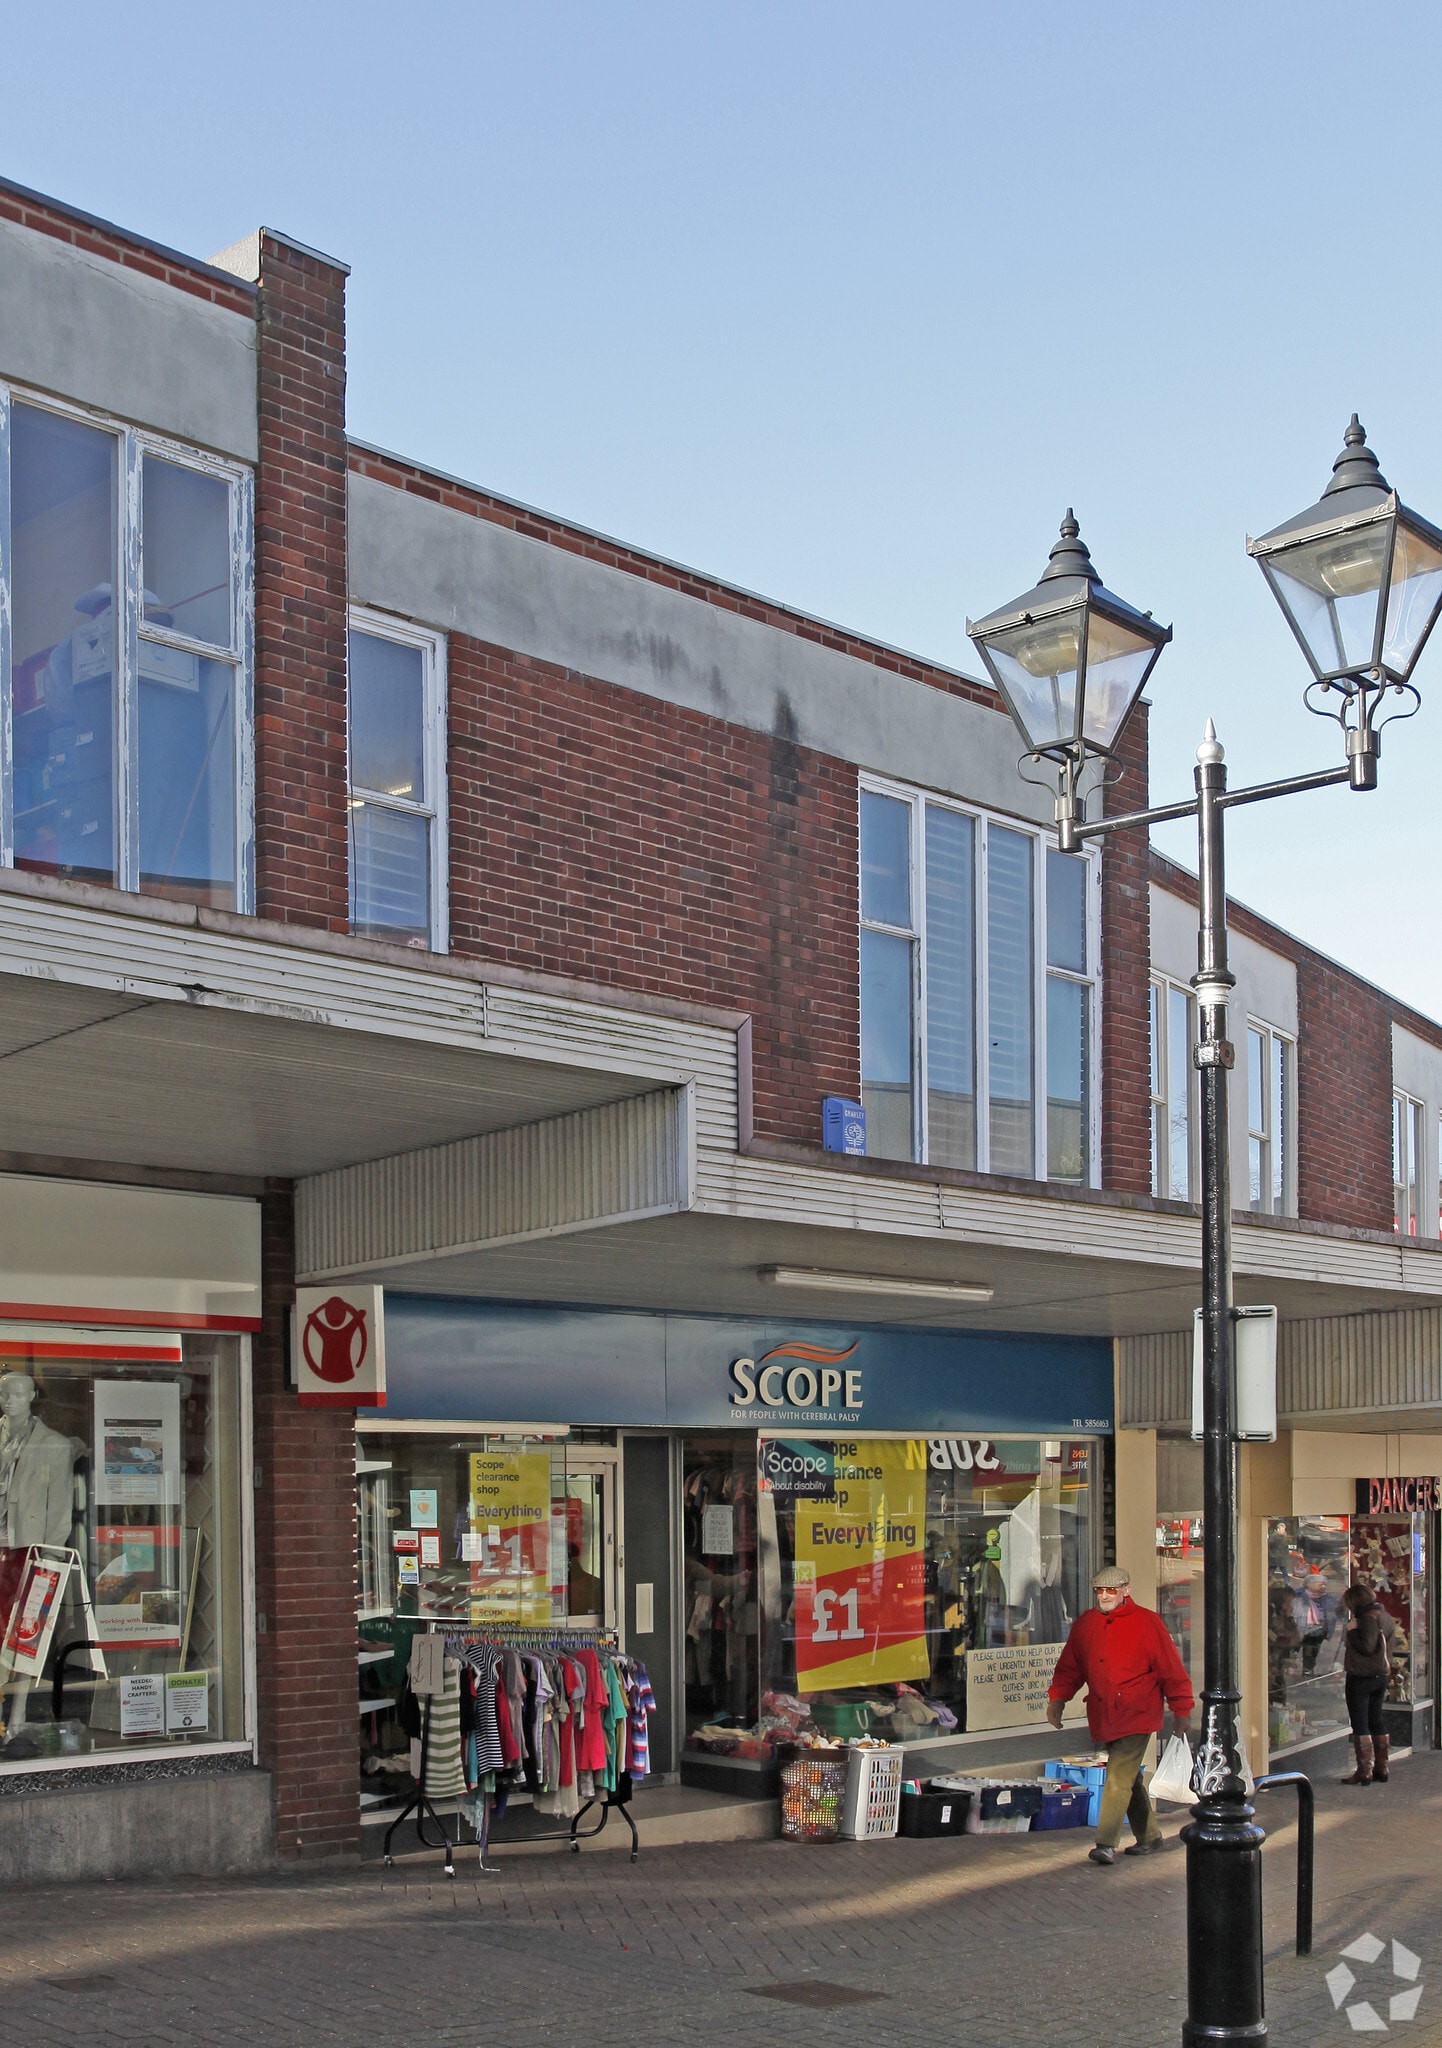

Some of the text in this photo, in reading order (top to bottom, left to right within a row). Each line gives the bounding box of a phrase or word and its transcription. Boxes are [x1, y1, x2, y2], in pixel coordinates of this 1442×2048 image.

[733, 1358, 864, 1408] SCOPE
[730, 1410, 860, 1422] FOR PEOPLE WITH CEREBRAL PALSY
[1072, 1418, 1082, 1428] TEL
[833, 1442, 858, 1460] ope
[476, 1460, 504, 1471] Scope
[768, 1452, 827, 1479] Scope
[476, 1472, 520, 1482] clearance
[834, 1465, 882, 1480] arance
[476, 1485, 500, 1496] shop
[770, 1480, 827, 1492] About disability
[1370, 1477, 1440, 1514] DANCERS
[477, 1504, 542, 1521] Everything
[478, 1608, 506, 1618] Scope
[812, 1588, 864, 1642] £1
[974, 1651, 994, 1662] PLEASE
[996, 1650, 1014, 1660] COULD
[1016, 1650, 1026, 1658] YOU
[1028, 1648, 1042, 1656] HELP
[1044, 1647, 1056, 1656] OUR
[988, 1662, 996, 1672] WE
[1000, 1660, 1026, 1670] URGENTLY
[1028, 1658, 1042, 1668] NEED
[974, 1668, 1055, 1684] PLEASE DONATE ANY UNWAN
[1002, 1682, 1024, 1692] CLOTHES
[1028, 1680, 1039, 1690] BRIC
[1004, 1694, 1021, 1703] SHOES
[1026, 1702, 1044, 1711] THANK
